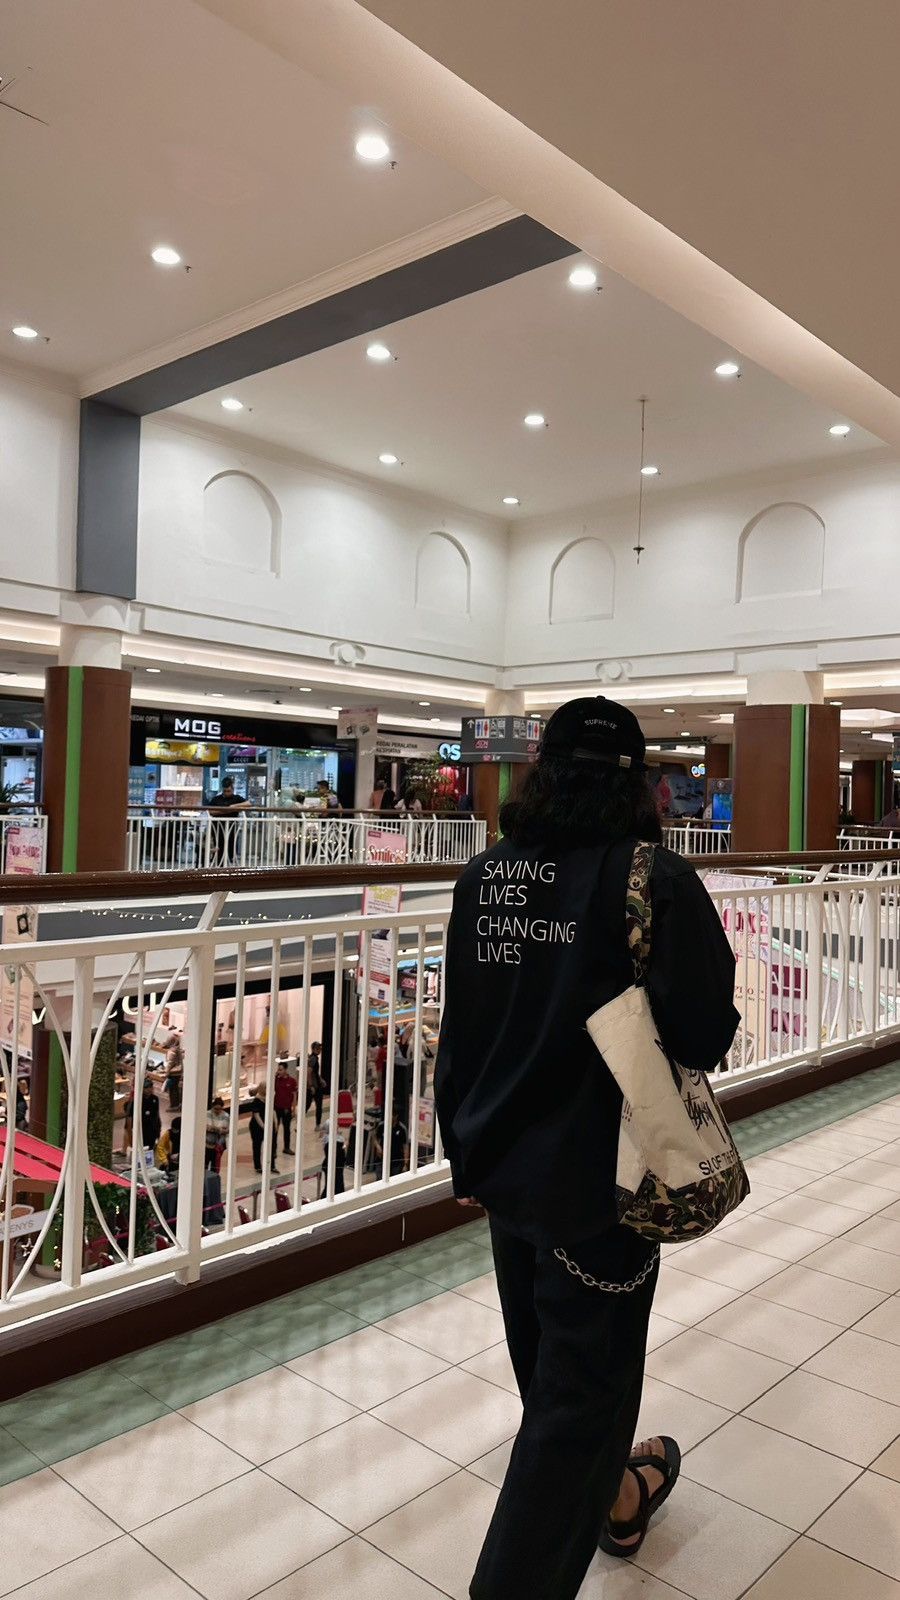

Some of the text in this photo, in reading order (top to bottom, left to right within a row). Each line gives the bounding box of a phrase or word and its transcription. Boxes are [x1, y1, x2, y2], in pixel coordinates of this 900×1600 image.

[174, 718, 221, 735] MOG
[482, 860, 556, 883] SAVING
[479, 885, 528, 906] LIVES
[477, 915, 576, 943] CHANGING
[477, 941, 521, 964] LIVES
